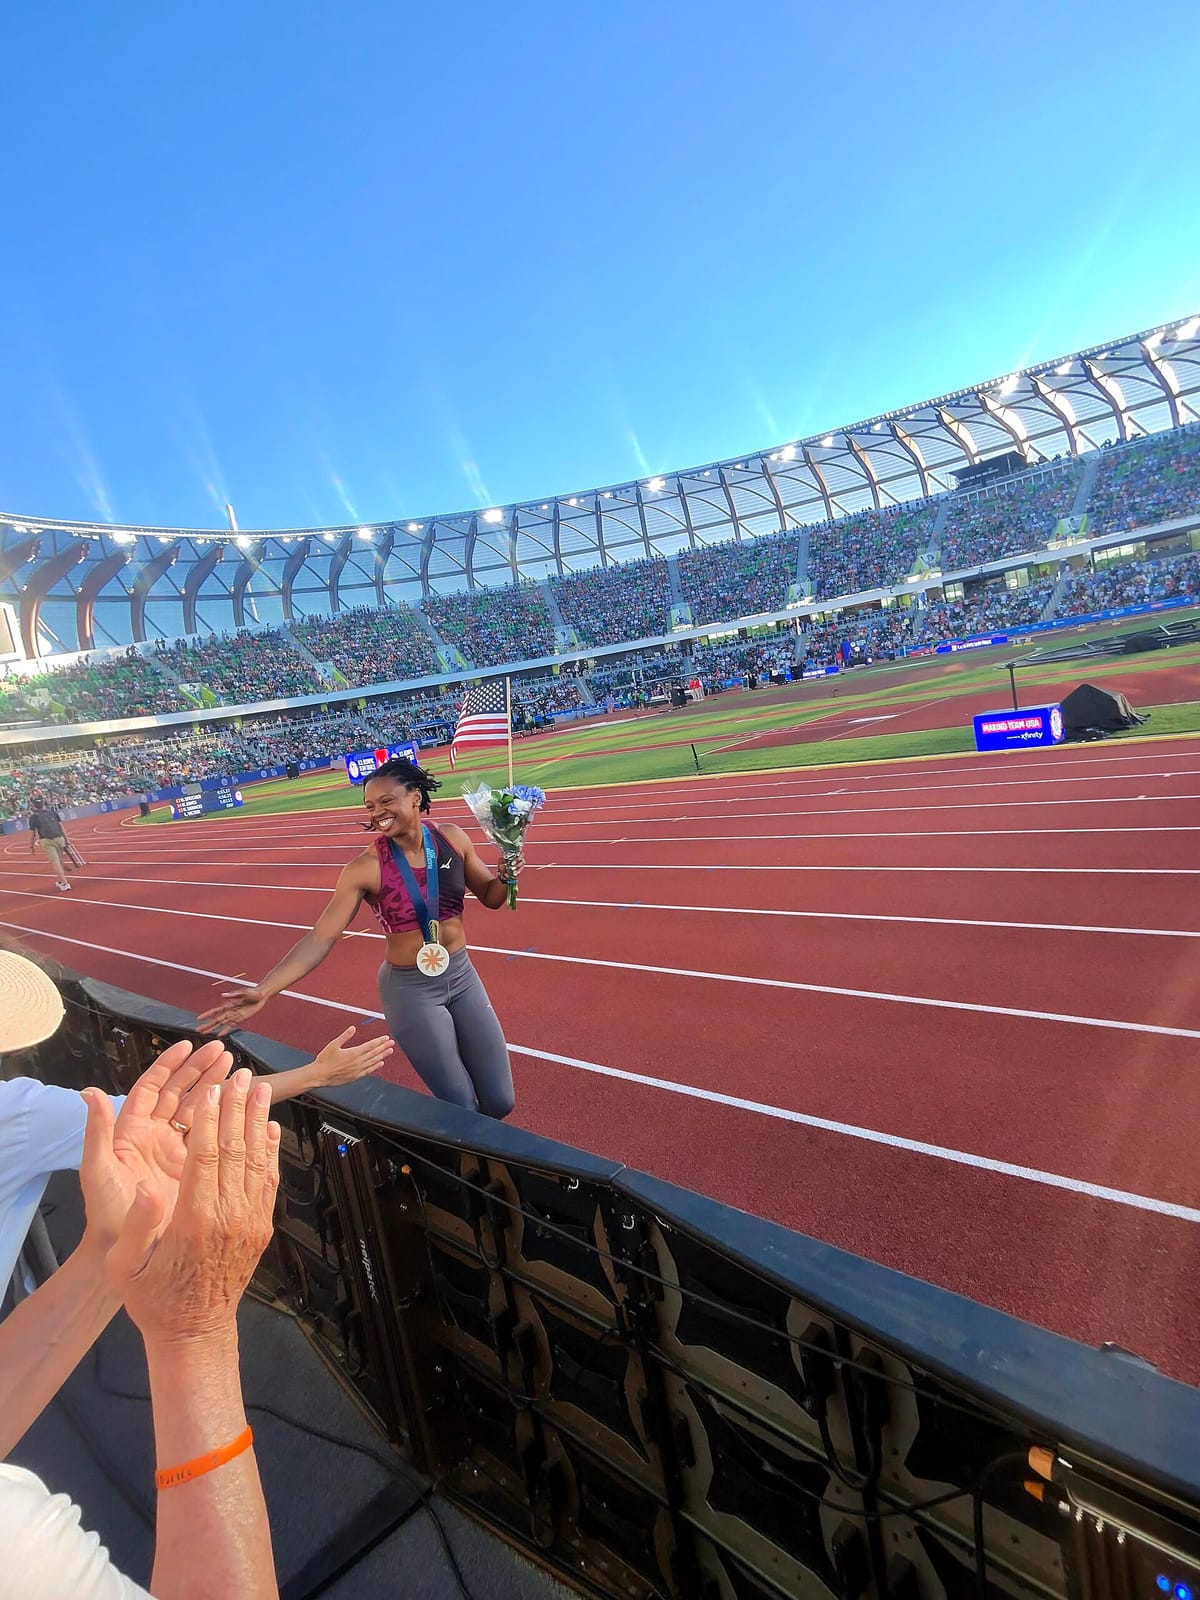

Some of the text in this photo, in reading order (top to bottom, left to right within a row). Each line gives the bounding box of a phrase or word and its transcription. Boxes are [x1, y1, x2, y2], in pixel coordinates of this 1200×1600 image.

[1007, 719, 1025, 730] TEAM
[1025, 718, 1040, 729] USA
[1020, 731, 1043, 741] xfinity
